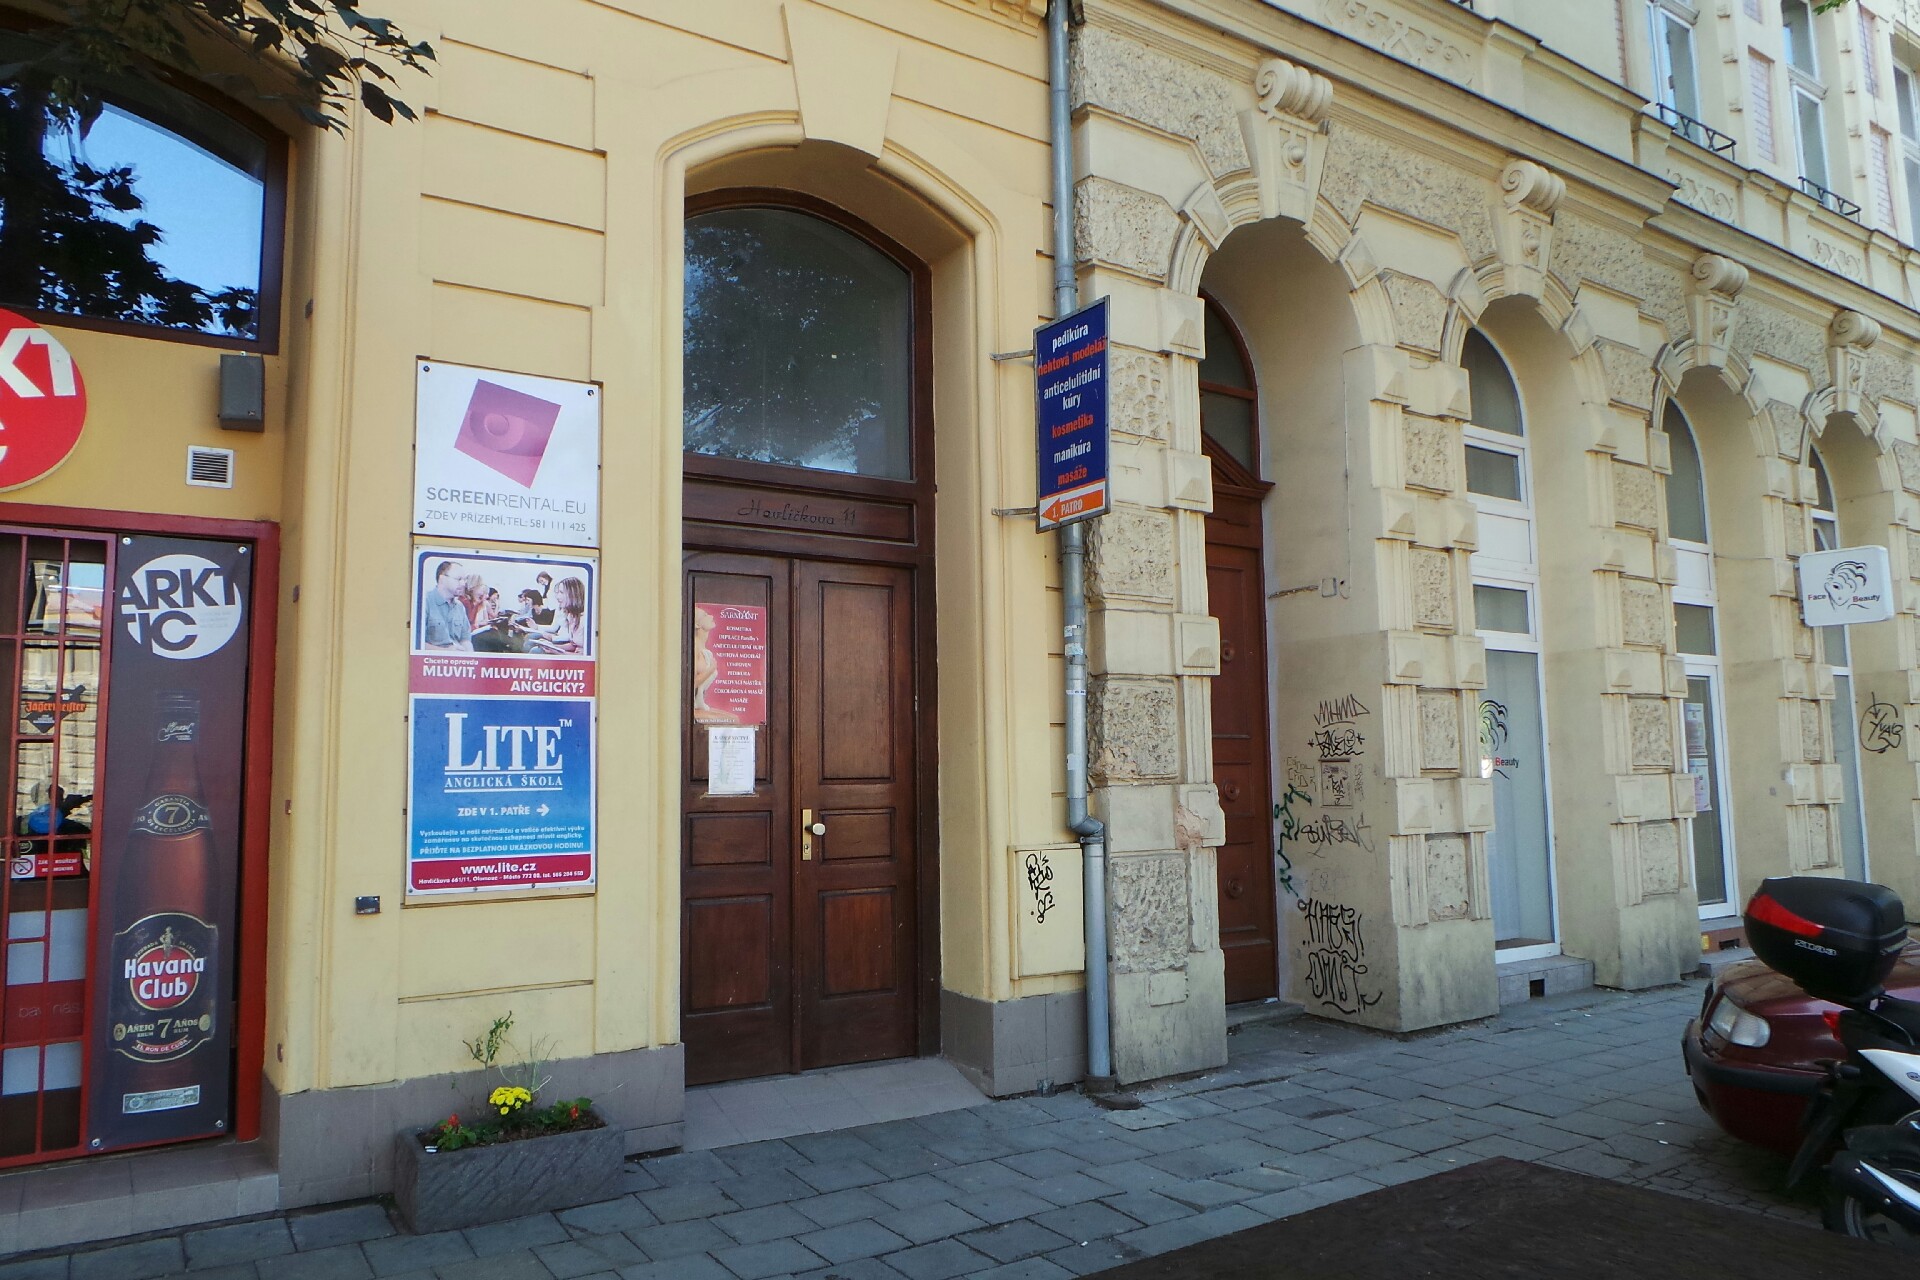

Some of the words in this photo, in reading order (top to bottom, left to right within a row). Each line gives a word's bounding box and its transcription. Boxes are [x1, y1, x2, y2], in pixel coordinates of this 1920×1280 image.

[1052, 324, 1089, 353] pedikúra
[1038, 351, 1070, 377] nehtová
[1073, 335, 1107, 363] modeláž
[1043, 363, 1101, 400] anticelulitidní
[1062, 393, 1082, 411] kúry
[1051, 413, 1094, 439] kosmetika
[1053, 439, 1092, 464] manikúra
[1057, 464, 1088, 486] masáže
[426, 487, 586, 515] SCREENRENTAL.EU
[1052, 506, 1059, 518] 1.
[1060, 498, 1083, 516] PATRO
[530, 518, 546, 529] 581
[569, 522, 586, 532] 425
[842, 507, 857, 527] 11
[1852, 594, 1881, 603] Beauty
[450, 658, 479, 666] opravdu
[422, 665, 477, 680] MLUVIT,
[480, 666, 533, 681] MLUVIT,
[537, 668, 585, 681] MLUVIT
[510, 680, 586, 694] ANGLICKY?
[444, 712, 563, 771] LITE
[1495, 757, 1519, 769] Beauty
[444, 775, 513, 788] ANGLICKÁ
[521, 774, 564, 787] ŠKOLA
[165, 806, 180, 824] 7
[457, 807, 478, 817] ZDE
[480, 807, 488, 816] V
[489, 807, 499, 816] 1.
[500, 804, 531, 816] PATŘE
[462, 844, 508, 854] BEZPLATNOU
[509, 842, 553, 852] UKÁZKOVOU
[554, 842, 584, 850] HODINU!
[460, 862, 537, 875] www.lite.cz
[473, 874, 498, 882] Olomouc
[124, 957, 205, 979] Havana
[138, 977, 188, 1000] Club
[127, 1024, 155, 1034] AÑEJO
[157, 1018, 173, 1039] 7
[173, 1018, 198, 1029] AÑOS
